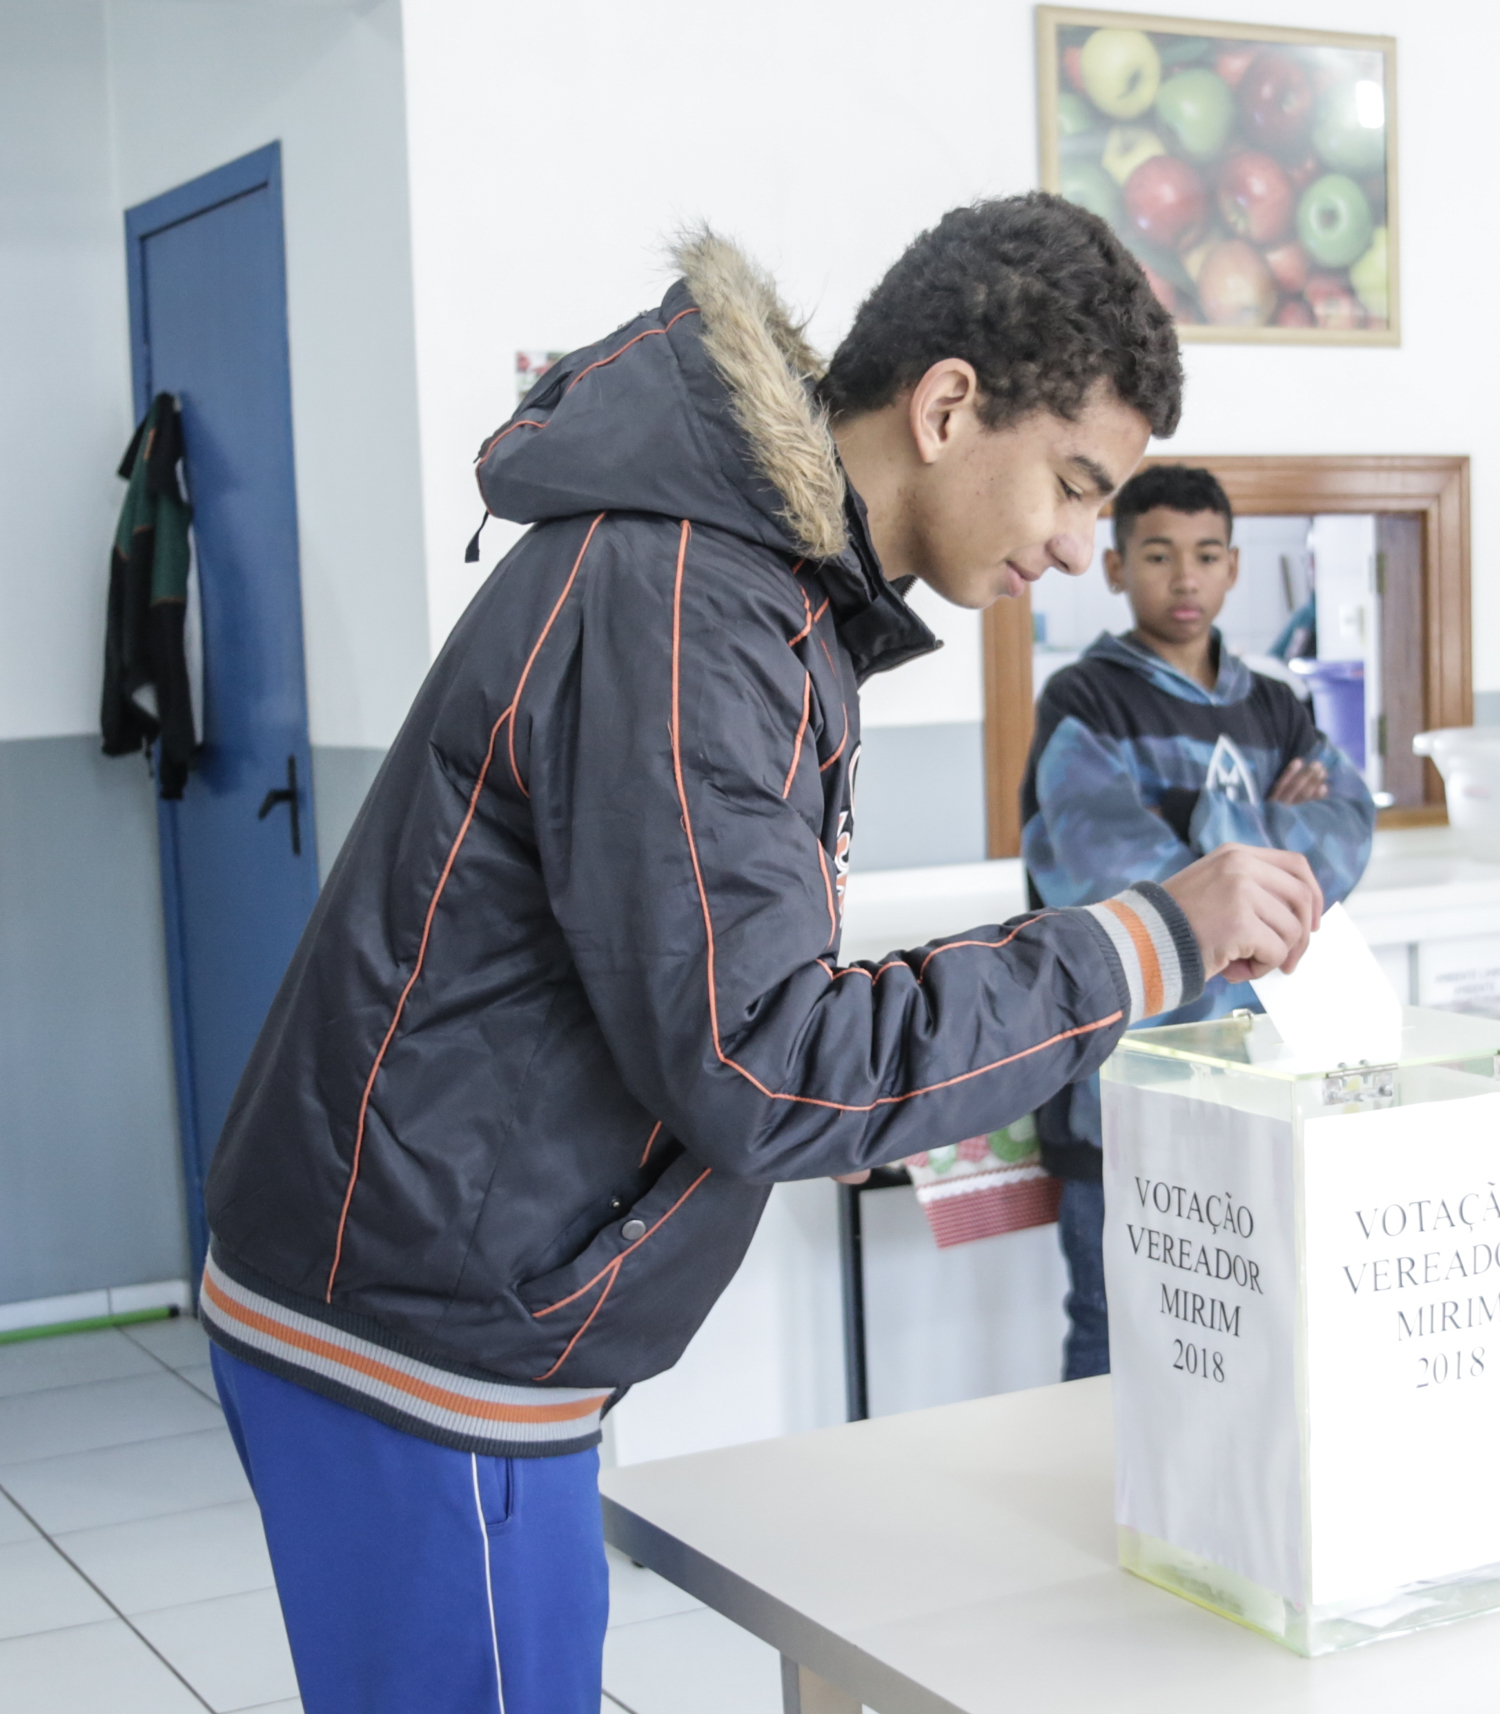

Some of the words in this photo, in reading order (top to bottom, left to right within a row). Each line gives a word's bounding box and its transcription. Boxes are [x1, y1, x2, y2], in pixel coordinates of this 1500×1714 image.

[1134, 1176, 1254, 1239] VOTAÇÃO
[1126, 1223, 1264, 1295] VEREADOR
[1159, 1282, 1241, 1338] MIRIM
[1172, 1338, 1226, 1384] 2018
[1415, 1346, 1487, 1389] 2018
